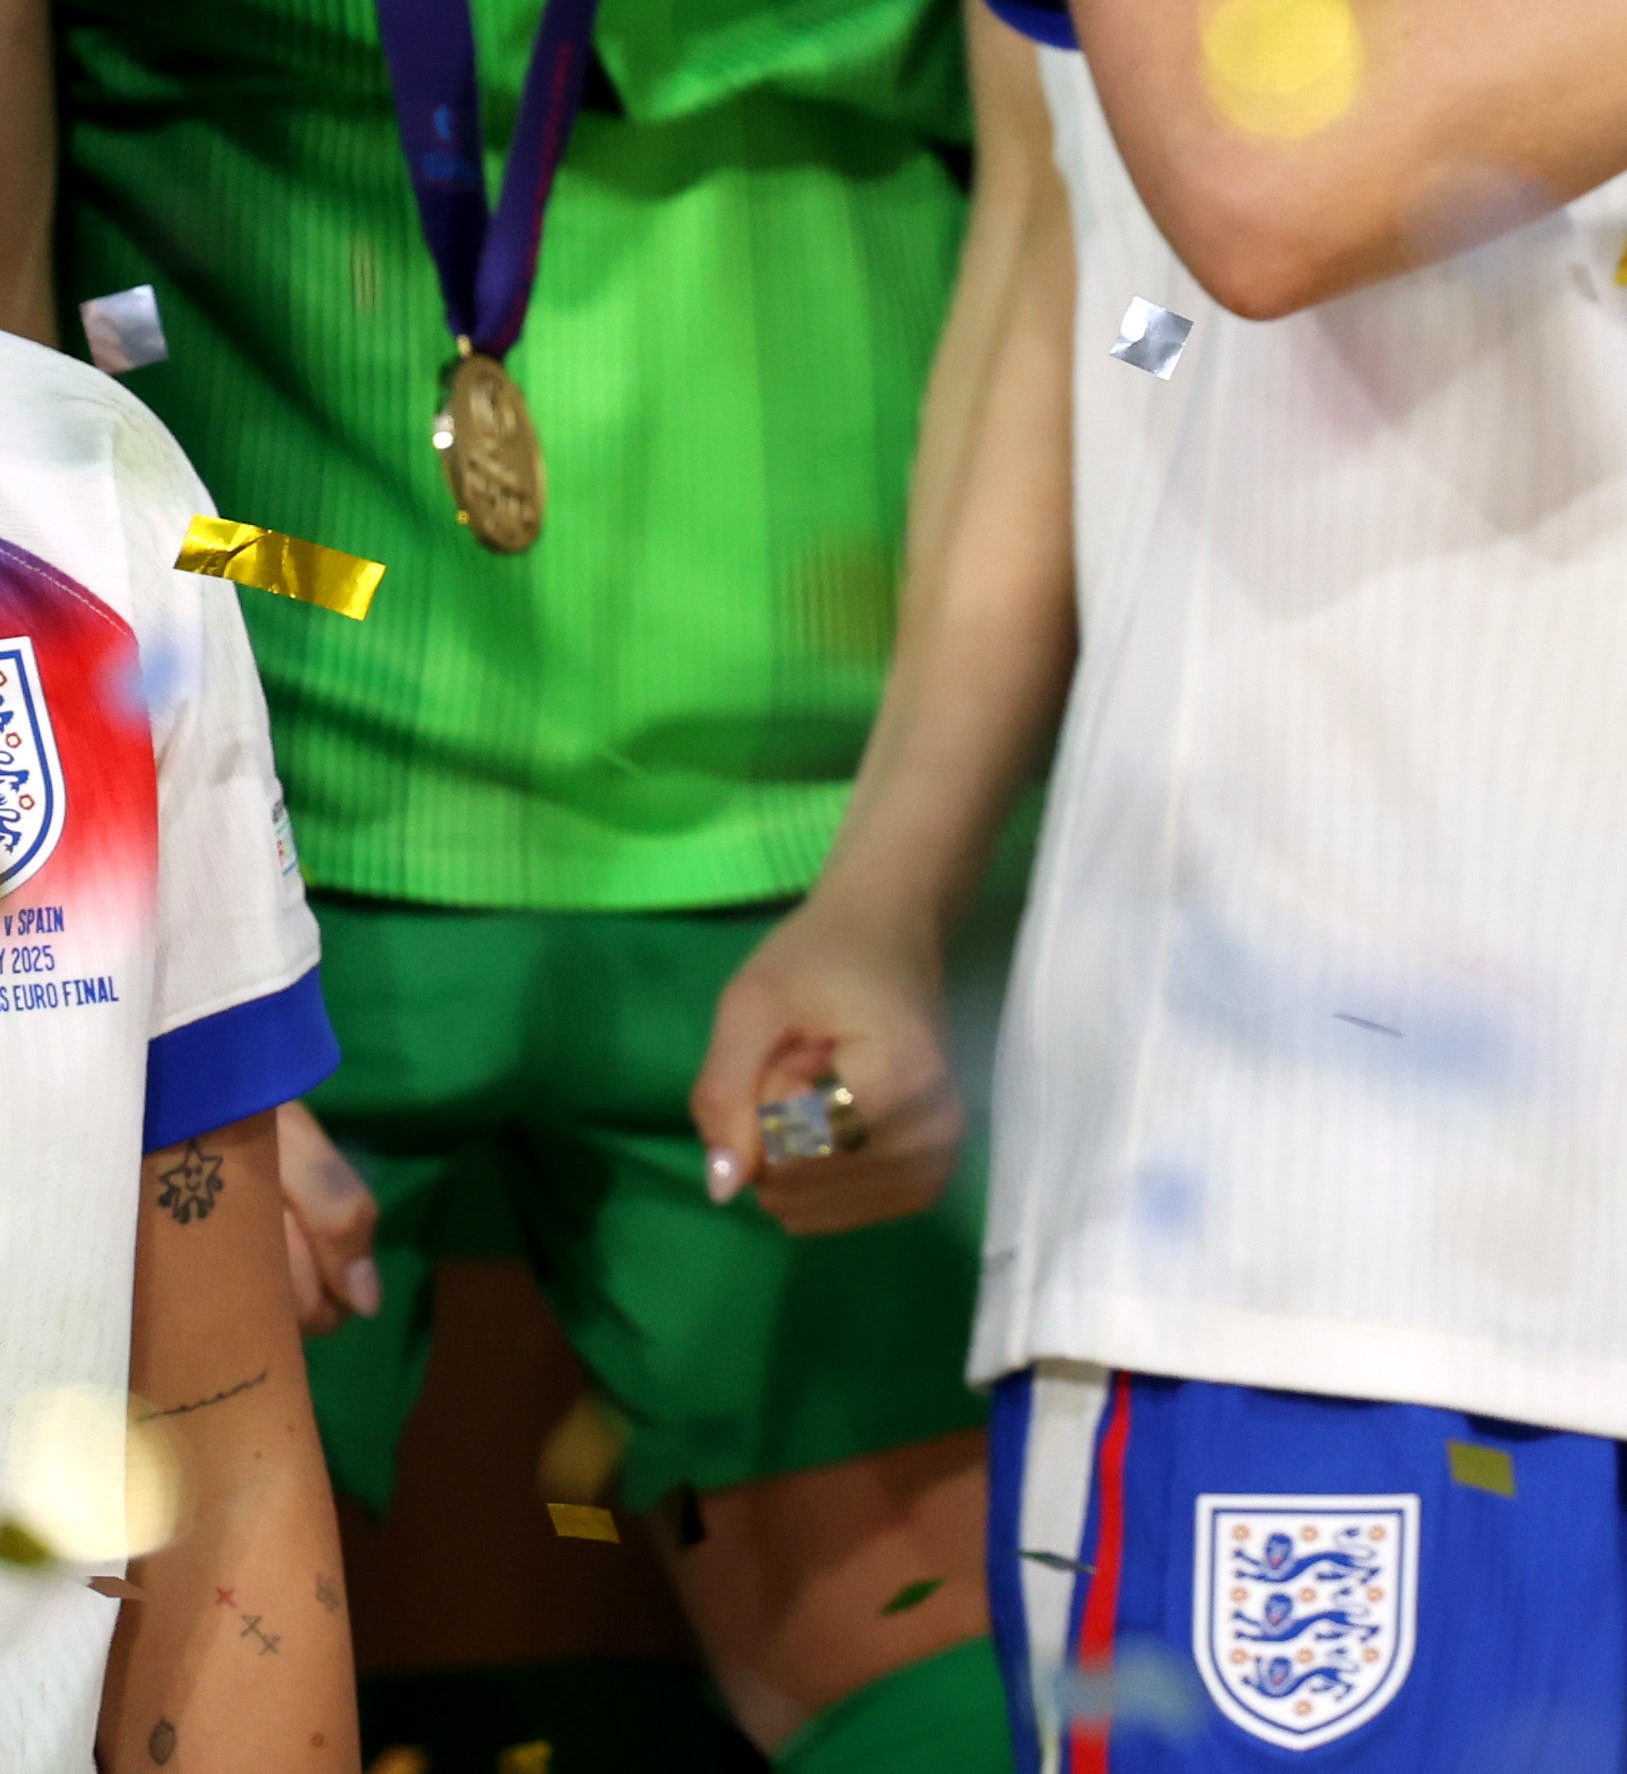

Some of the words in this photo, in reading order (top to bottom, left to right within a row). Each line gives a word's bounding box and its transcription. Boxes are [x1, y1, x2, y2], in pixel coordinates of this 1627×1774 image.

[17, 906, 64, 936] SPAIN
[11, 945, 55, 974] 2025
[12, 982, 58, 1011] EURO
[62, 976, 119, 1007] FINAL
